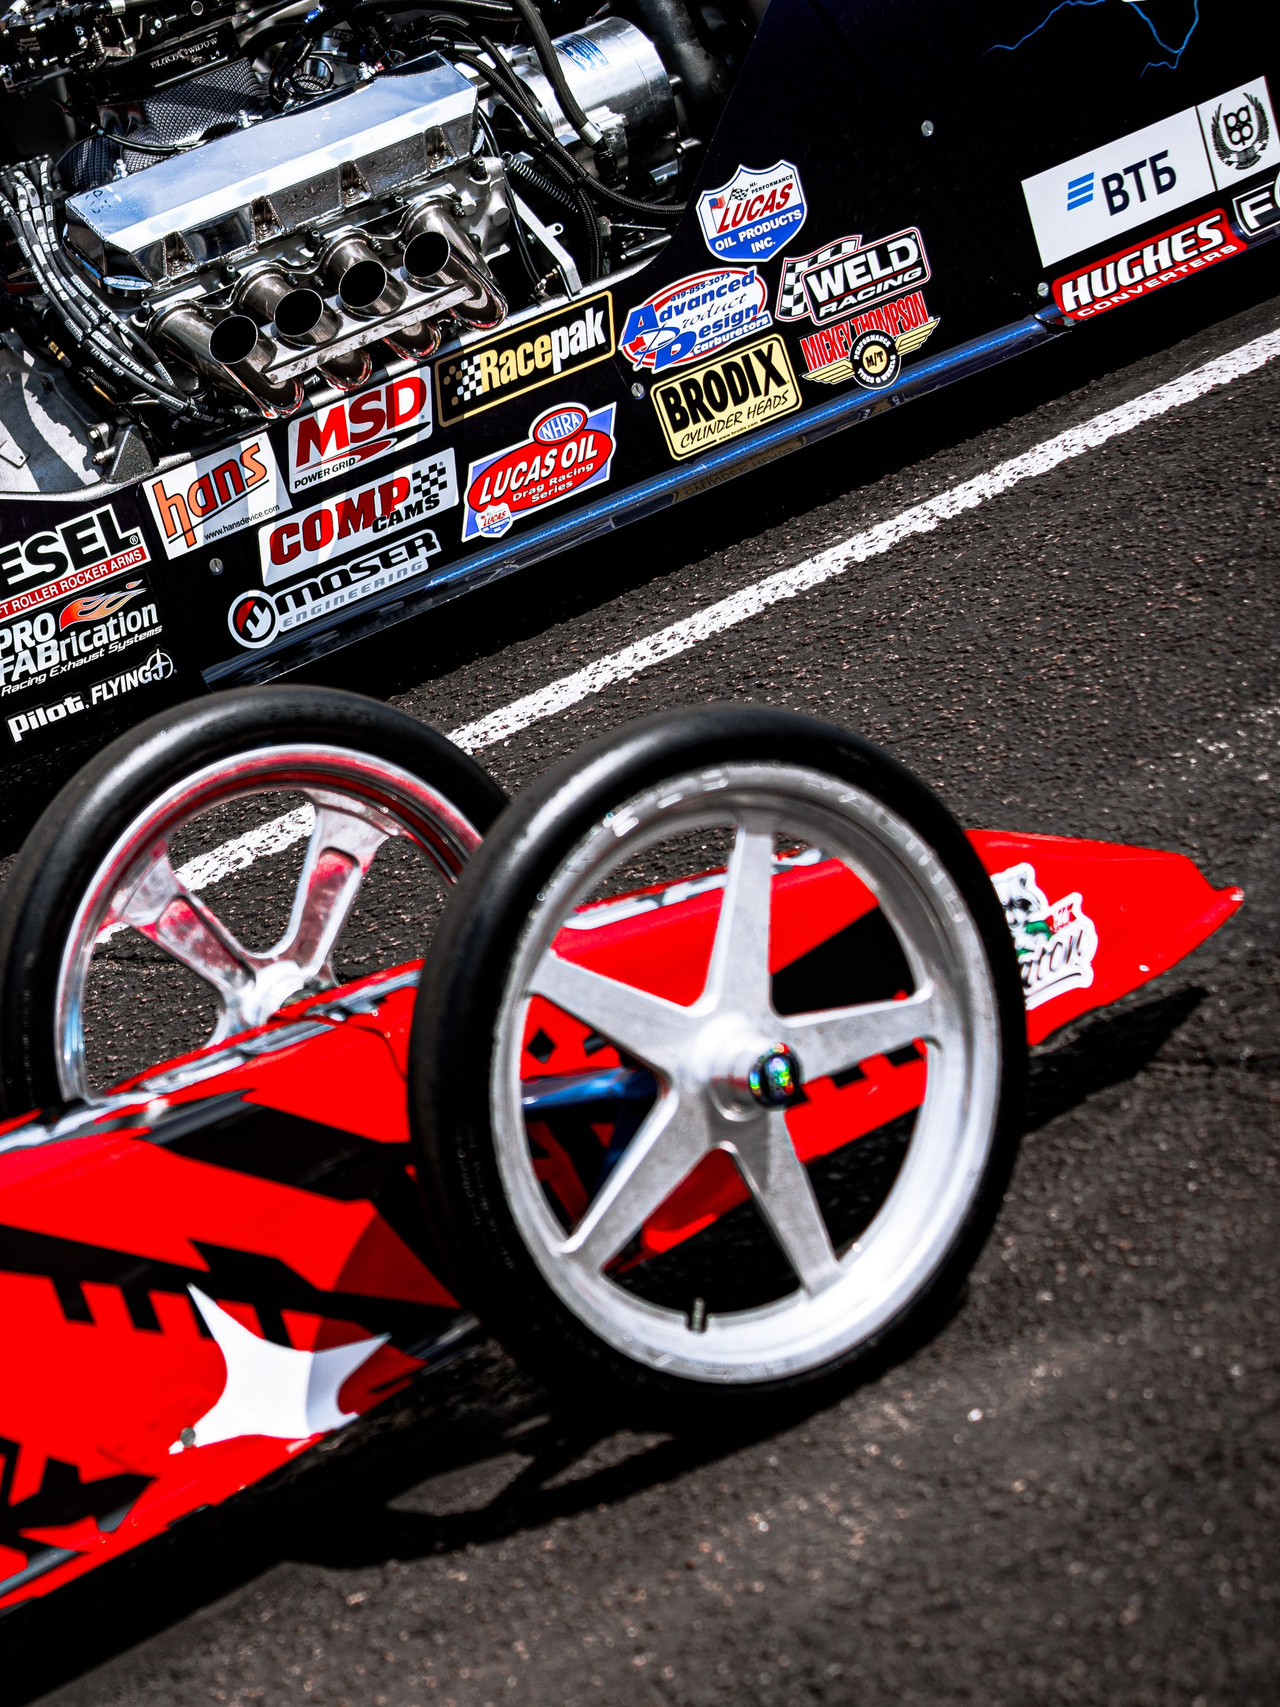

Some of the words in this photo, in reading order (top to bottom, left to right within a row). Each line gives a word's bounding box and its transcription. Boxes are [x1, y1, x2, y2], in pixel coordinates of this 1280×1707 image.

[717, 182, 794, 234] LUCAS
[751, 174, 794, 194] PERFORMANCE
[1101, 149, 1177, 217] ВТБ
[715, 236, 737, 251] OIL
[738, 209, 802, 243] PRODUCTS
[750, 236, 776, 254] INC.
[670, 272, 731, 302] 419-855-3073
[806, 237, 919, 303] WELD
[819, 267, 923, 318] RACING
[1061, 214, 1225, 313] HUGHES
[1076, 244, 1238, 318] CONVERTERS
[622, 269, 755, 346] Advanced
[800, 320, 853, 372] MICKEY
[851, 290, 929, 337] THOMPSON
[90, 347, 113, 368] ULTRA
[112, 365, 125, 377] 40
[480, 307, 607, 394] Racepak
[654, 304, 759, 370] Design
[854, 334, 892, 360] PERFORMANCE
[865, 351, 884, 368] M/T
[120, 355, 144, 376] ULTRA
[143, 371, 157, 383] 40
[659, 342, 788, 434] BRODIX
[295, 376, 427, 468] MSD
[540, 413, 580, 440] NHRA
[680, 411, 743, 448] CYLINDER
[747, 390, 789, 420] HEADS
[152, 441, 268, 548] hans
[294, 467, 331, 489] POWER
[331, 457, 356, 477] GRID
[479, 448, 558, 505] LUCAS
[561, 434, 598, 469] OIL
[512, 484, 544, 502] Drag
[549, 462, 594, 486] Racing
[531, 480, 573, 503] Series
[204, 503, 280, 542] www.hansdevice.com
[269, 476, 411, 566] COMP
[371, 493, 440, 535] CAMS
[483, 510, 507, 527] LUCAS
[11, 584, 60, 612] ROLLER
[60, 564, 109, 591] ROCKER
[110, 549, 143, 571] ARMS
[274, 531, 437, 617] MOSER
[282, 560, 424, 628] ENGINEERING
[1, 673, 47, 697] Racing
[49, 650, 106, 678] Exhaust
[108, 625, 163, 656] Systems
